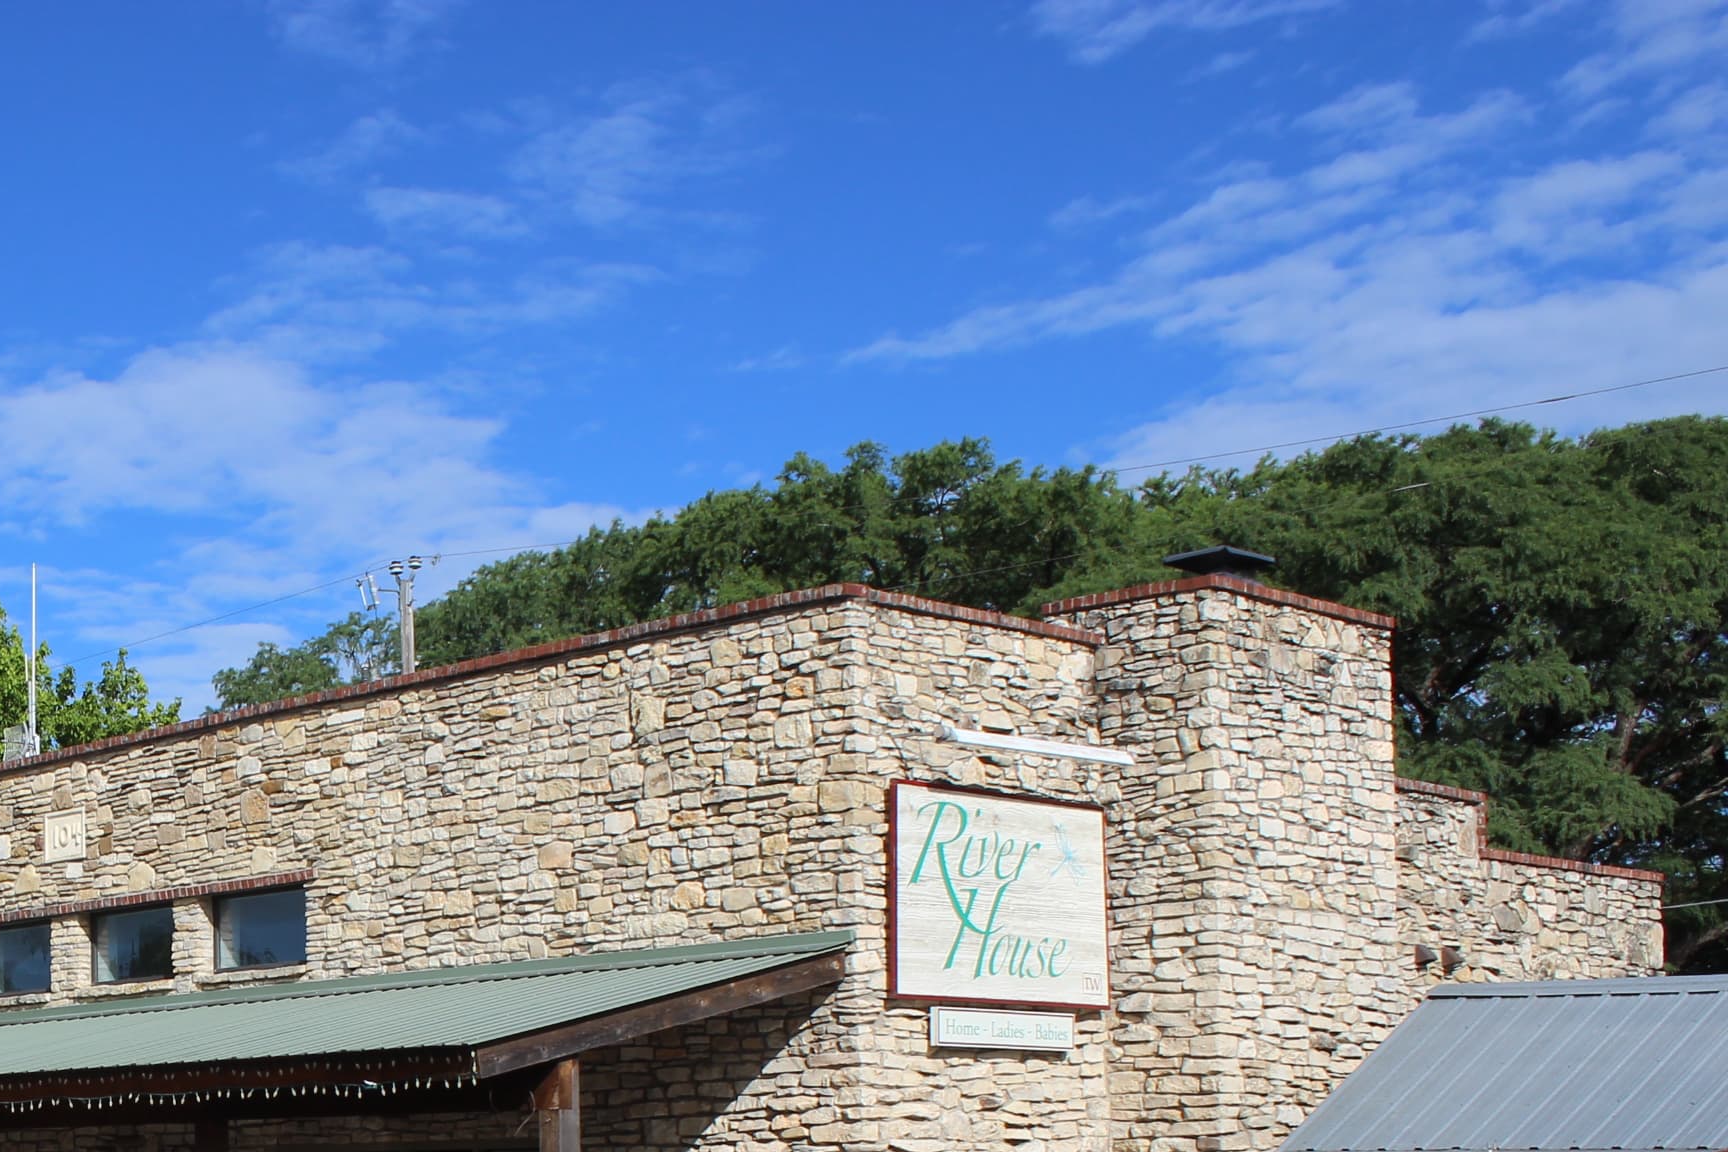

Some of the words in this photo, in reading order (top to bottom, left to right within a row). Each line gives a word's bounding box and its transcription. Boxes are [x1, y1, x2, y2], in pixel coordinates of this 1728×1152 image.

[907, 801, 1042, 934] River
[943, 879, 1073, 980] House
[945, 1018, 981, 1037] Home
[991, 1021, 1024, 1039] Ladies
[1035, 1023, 1068, 1041] Babies
